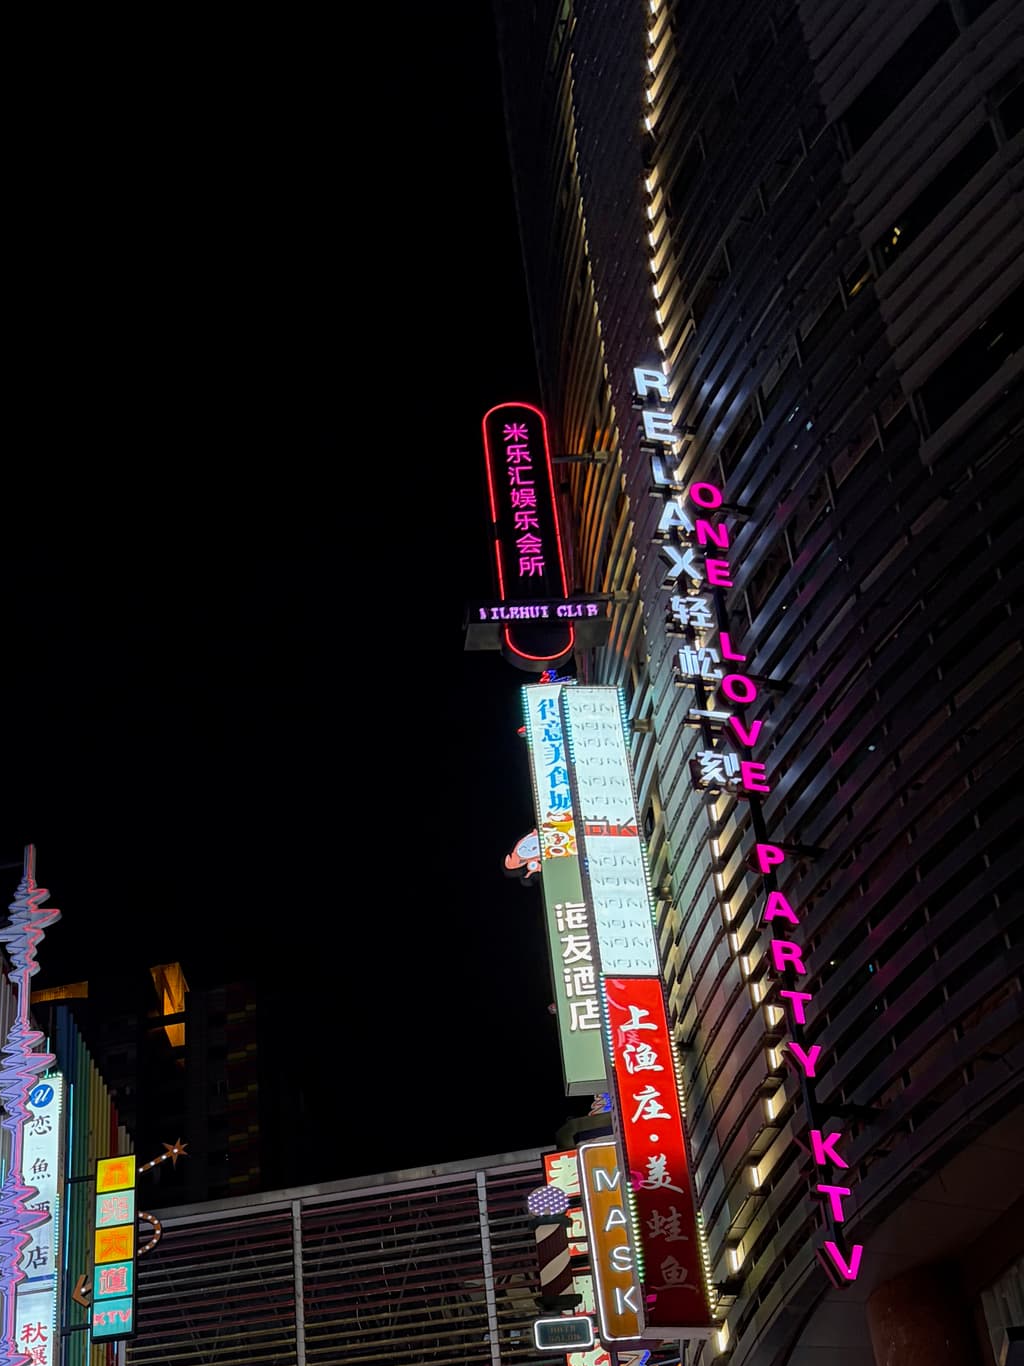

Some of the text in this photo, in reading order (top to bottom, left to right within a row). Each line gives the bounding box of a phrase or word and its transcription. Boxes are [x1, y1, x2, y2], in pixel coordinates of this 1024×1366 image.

[503, 423, 545, 577] 米乐汇娱乐会所
[634, 367, 702, 580] RELAX
[670, 596, 743, 786] 轻松一刻
[690, 482, 863, 1282] ONE LOVE PARTY KTV
[93, 1307, 134, 1327] KTV
[591, 1168, 640, 1317] MASK
